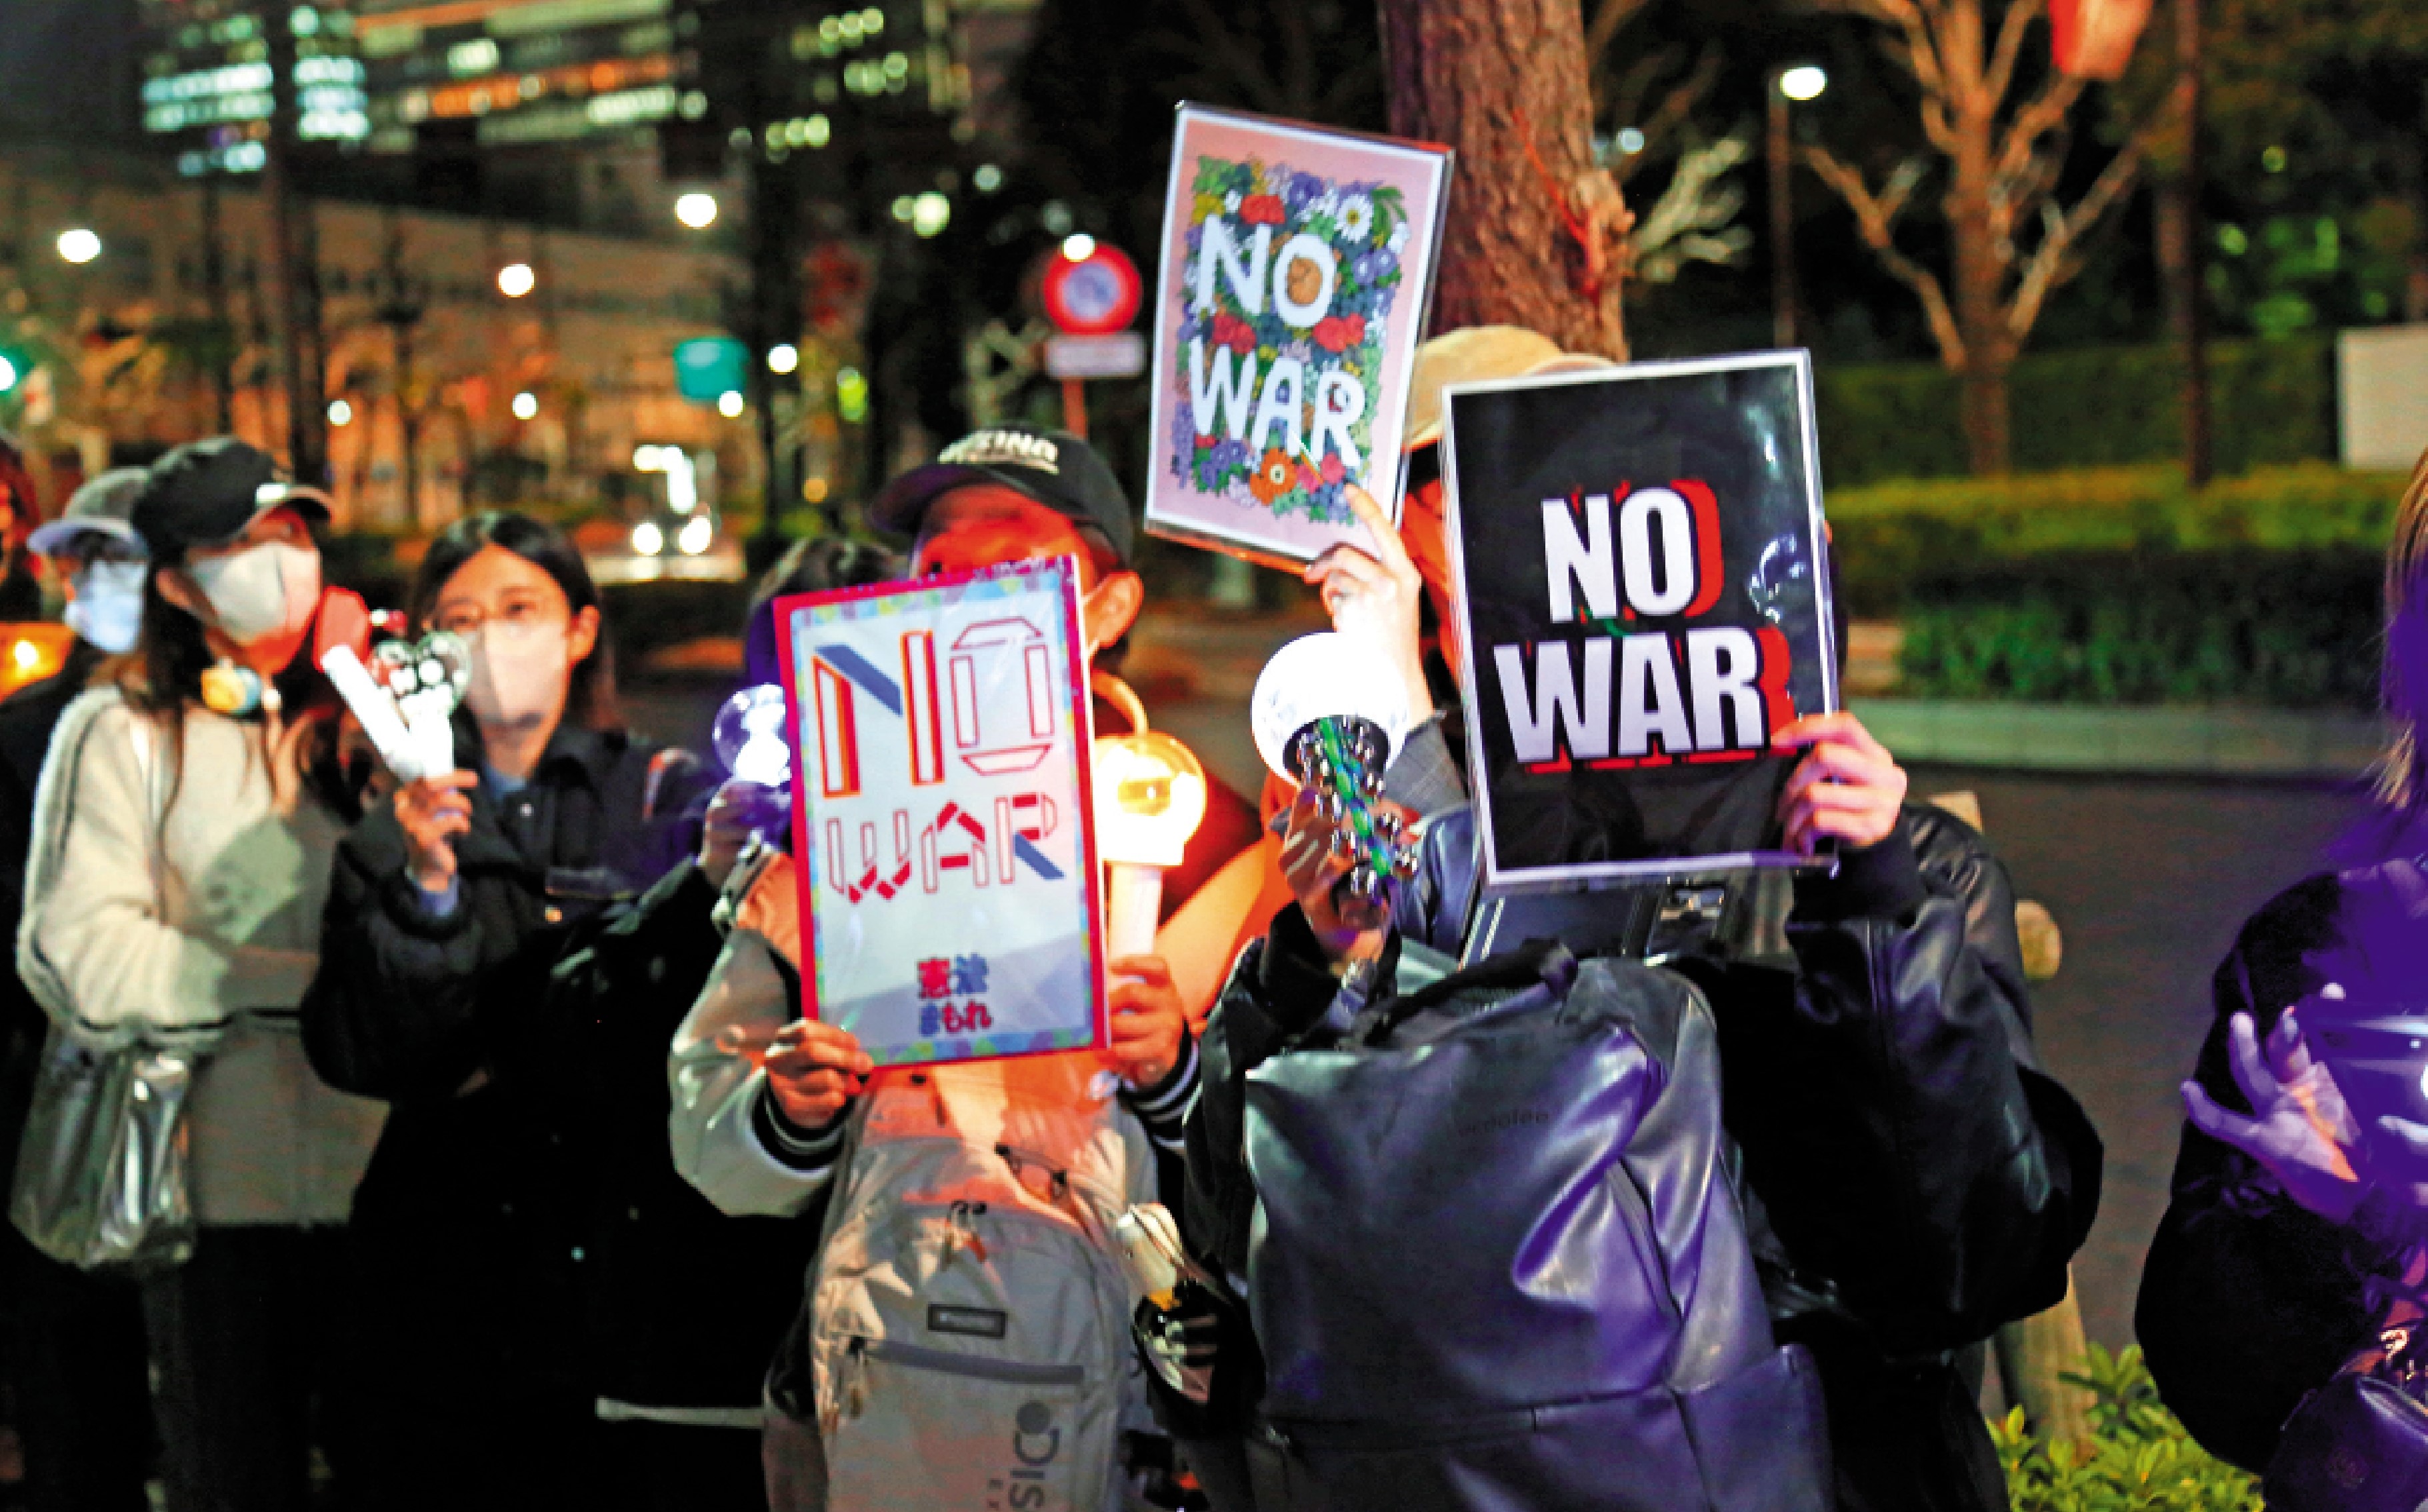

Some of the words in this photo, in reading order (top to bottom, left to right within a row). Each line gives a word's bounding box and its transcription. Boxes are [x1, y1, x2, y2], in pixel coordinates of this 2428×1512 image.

[1199, 213, 1336, 328] NO
[1189, 335, 1366, 467] WAR
[1540, 486, 1697, 624] NO
[811, 617, 1055, 799] NO
[1493, 625, 1765, 765] WAR
[827, 791, 1066, 905] WAR
